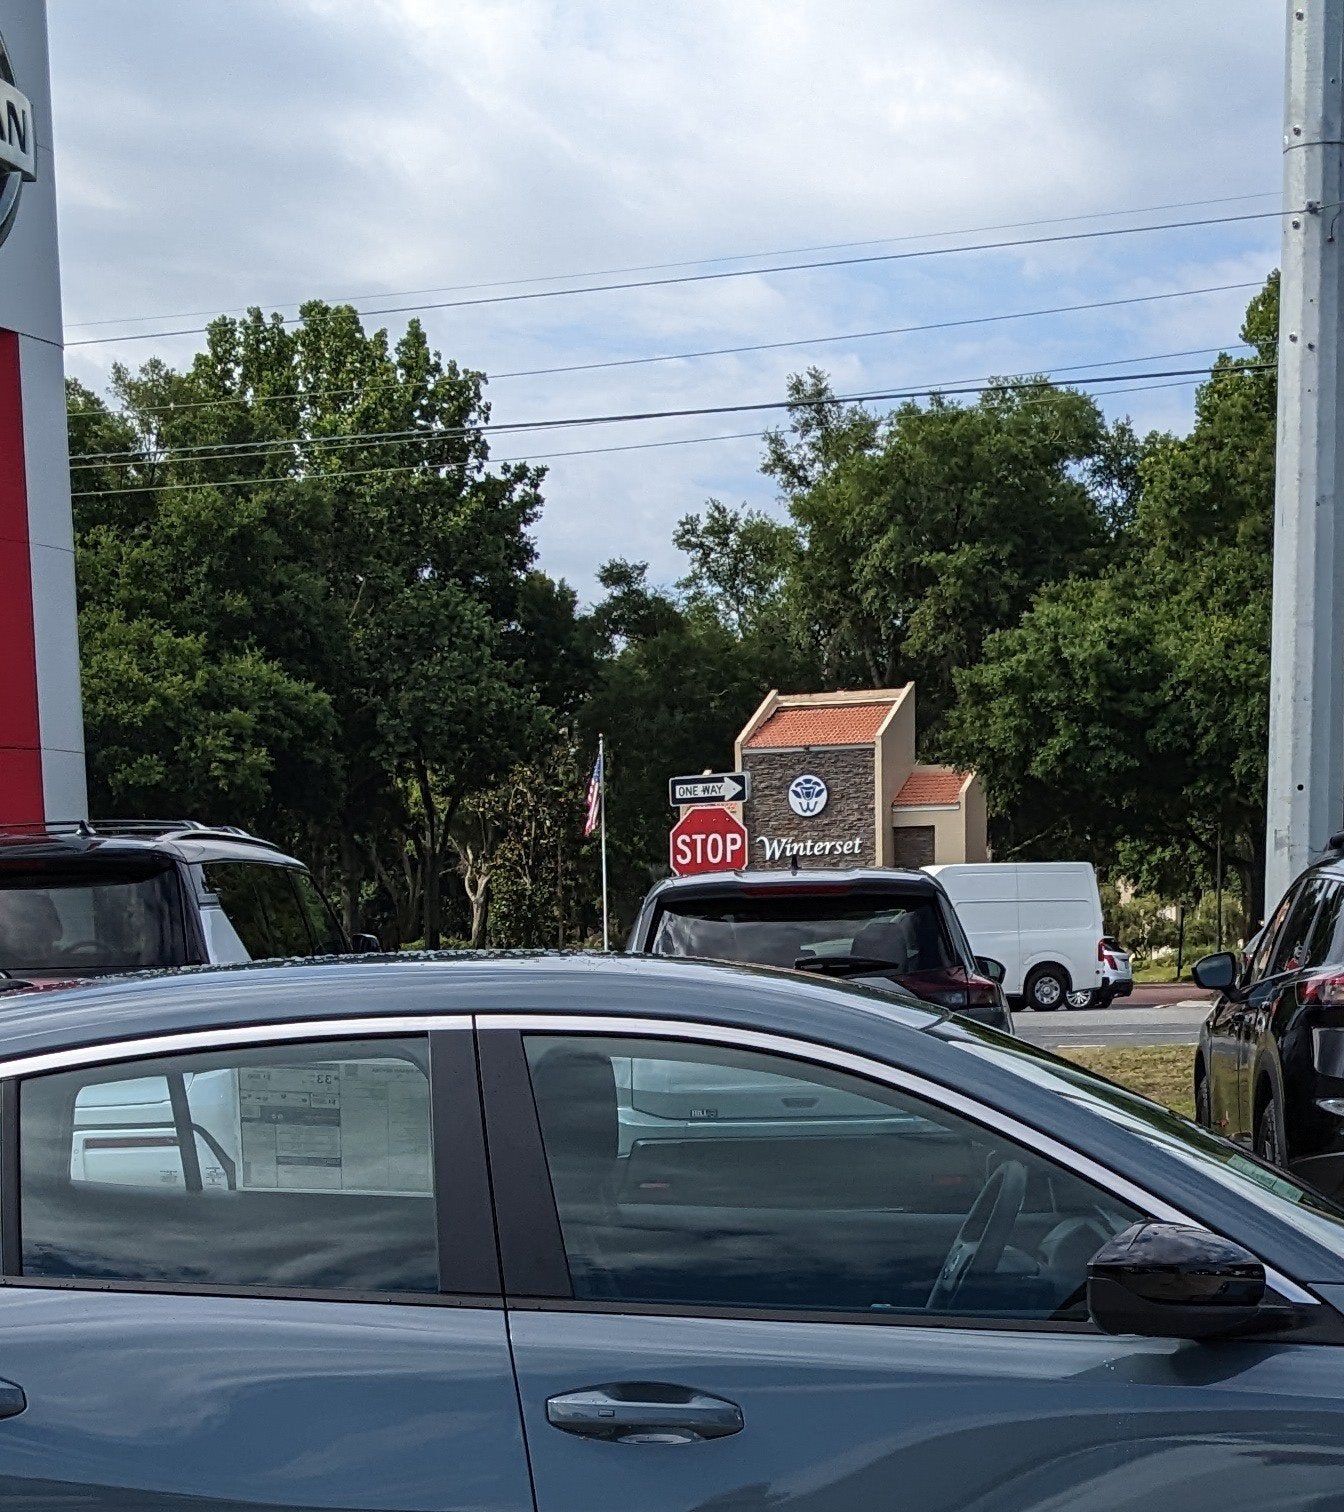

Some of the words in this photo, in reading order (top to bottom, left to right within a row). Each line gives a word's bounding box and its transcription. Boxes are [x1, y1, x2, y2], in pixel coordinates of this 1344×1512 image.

[678, 785, 698, 797] ONE
[701, 784, 723, 795] WAY
[676, 833, 742, 865] STOP
[756, 836, 863, 861] Winterset
